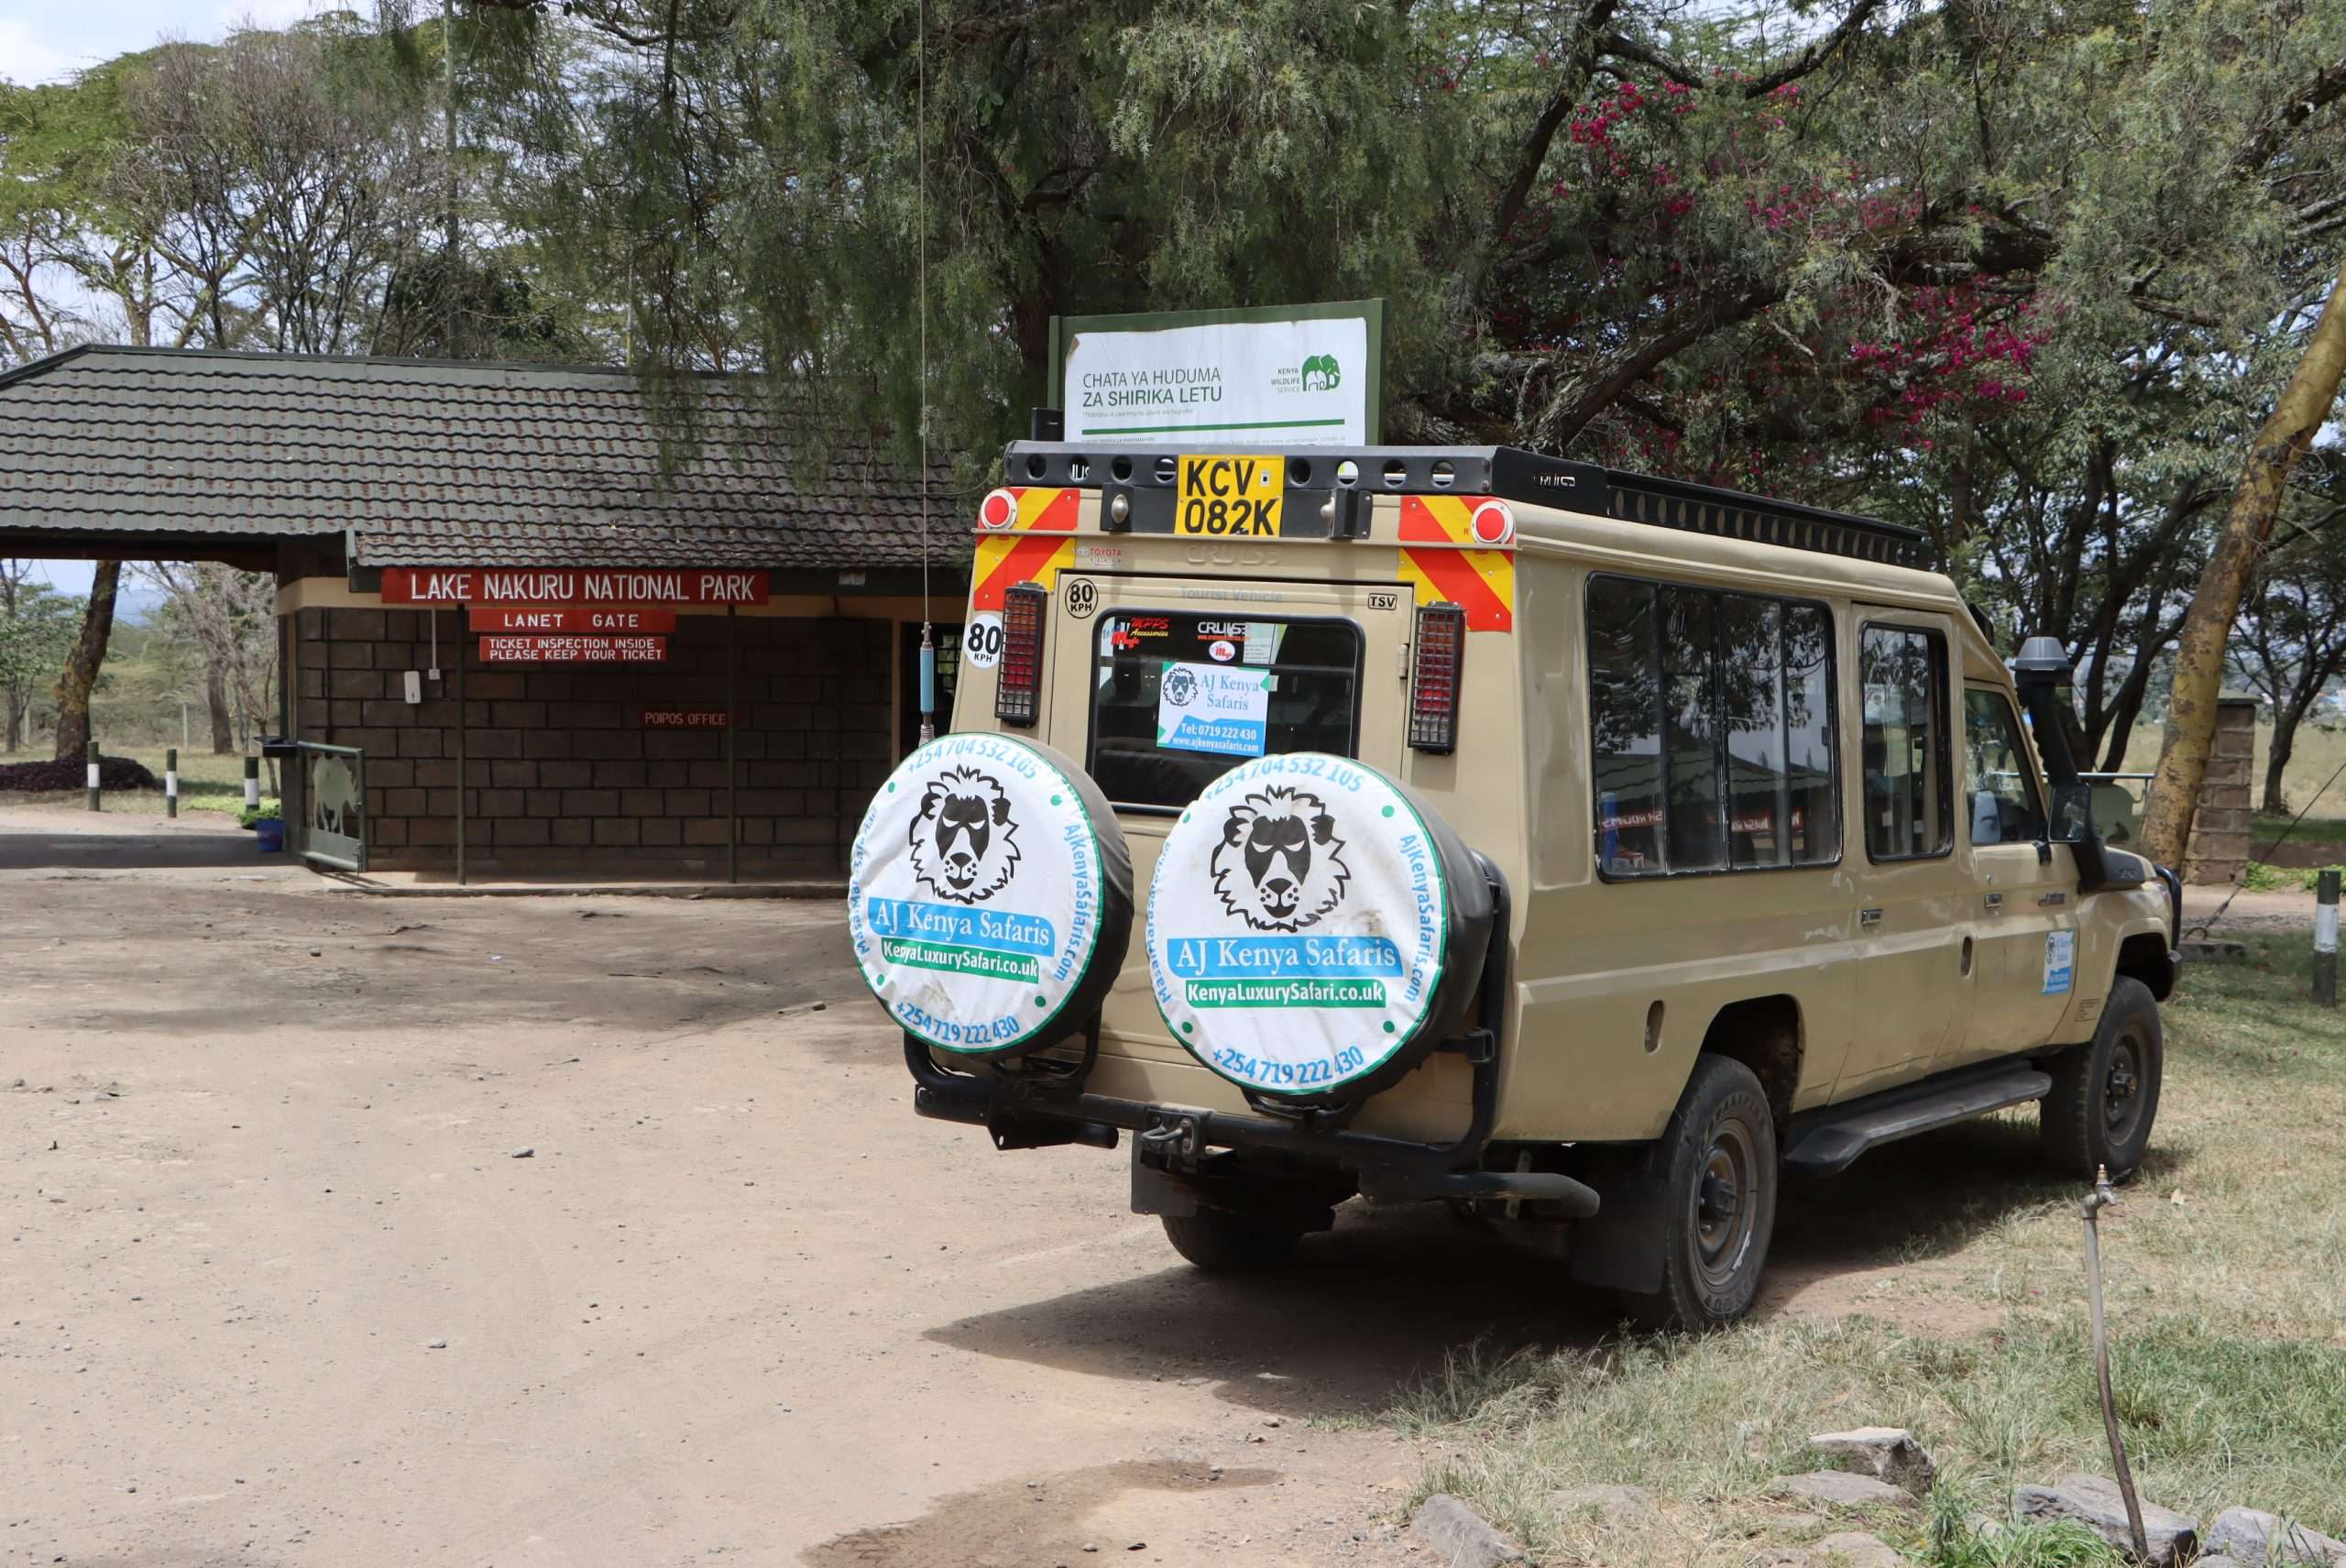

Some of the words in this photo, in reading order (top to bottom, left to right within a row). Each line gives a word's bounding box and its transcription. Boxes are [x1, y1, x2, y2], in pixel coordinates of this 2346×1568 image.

[1083, 371, 1127, 389] CHATA
[1131, 370, 1148, 386] YA
[1154, 367, 1221, 385] HUDUMA
[1271, 378, 1299, 386] WILDLIFE
[1083, 391, 1103, 407] ZA
[1108, 389, 1176, 406] SHIRIKA
[1180, 386, 1222, 403] LETU
[1187, 459, 1255, 497] KCV
[1185, 499, 1278, 535] 082K
[1091, 548, 1122, 556] TOYOTA
[411, 574, 472, 599] LAKE
[484, 574, 574, 599] NAKURU
[584, 574, 689, 600] NATIONAL
[700, 575, 755, 601] PARK
[1070, 585, 1093, 603] 80
[1180, 587, 1228, 600] Tourist
[1233, 588, 1284, 602] Vehicle
[1070, 603, 1092, 612] KPH
[1370, 596, 1395, 607] TSV
[504, 614, 564, 628] LANET
[592, 614, 639, 628] GATE
[489, 639, 531, 649] TICKET
[537, 639, 608, 649] INSPECTION
[615, 639, 654, 650] INSIDE
[968, 623, 1002, 654] 80
[490, 650, 539, 660] PLEASE
[545, 650, 577, 661] KEEP
[584, 650, 616, 661] YOUR
[621, 650, 663, 661] TICKET
[974, 652, 992, 663] KPH
[1200, 674, 1215, 690] AJ
[1220, 675, 1259, 696] Kenya
[1207, 695, 1249, 711] Safaris
[687, 713, 727, 725] OFFICE
[1181, 723, 1197, 735] Tel:
[1198, 724, 1220, 736] 0719
[1221, 726, 1238, 739] 222
[1239, 727, 1257, 740] 430
[946, 740, 976, 755] 704
[978, 740, 1005, 762] 532
[1172, 737, 1259, 753] www.ajkenyasafaris.com
[1204, 766, 1246, 800] +254
[1251, 759, 1285, 777] 704
[1288, 758, 1324, 775] 532
[1328, 764, 1362, 792] 105
[875, 902, 900, 936] AJ
[908, 904, 972, 943] Kenya
[980, 913, 1050, 947] Safaris
[1400, 834, 1435, 1003] AjKenyaSafaris.com
[883, 940, 1038, 978] KenyaLuxurySafari.co.uk
[1177, 941, 1208, 975] AJ
[1217, 939, 1299, 975] Kenya
[1306, 938, 1396, 967] Safaris
[1188, 981, 1383, 1003] KenyaLuxurySafari.co.uk
[896, 1003, 933, 1032] +254
[934, 1017, 961, 1042] 719
[964, 1023, 992, 1044] 222
[992, 1015, 1020, 1039] 430
[1212, 1047, 1255, 1079] +254
[1260, 1060, 1293, 1083] 719
[1298, 1059, 1332, 1084] 222
[1334, 1045, 1365, 1074] 430
